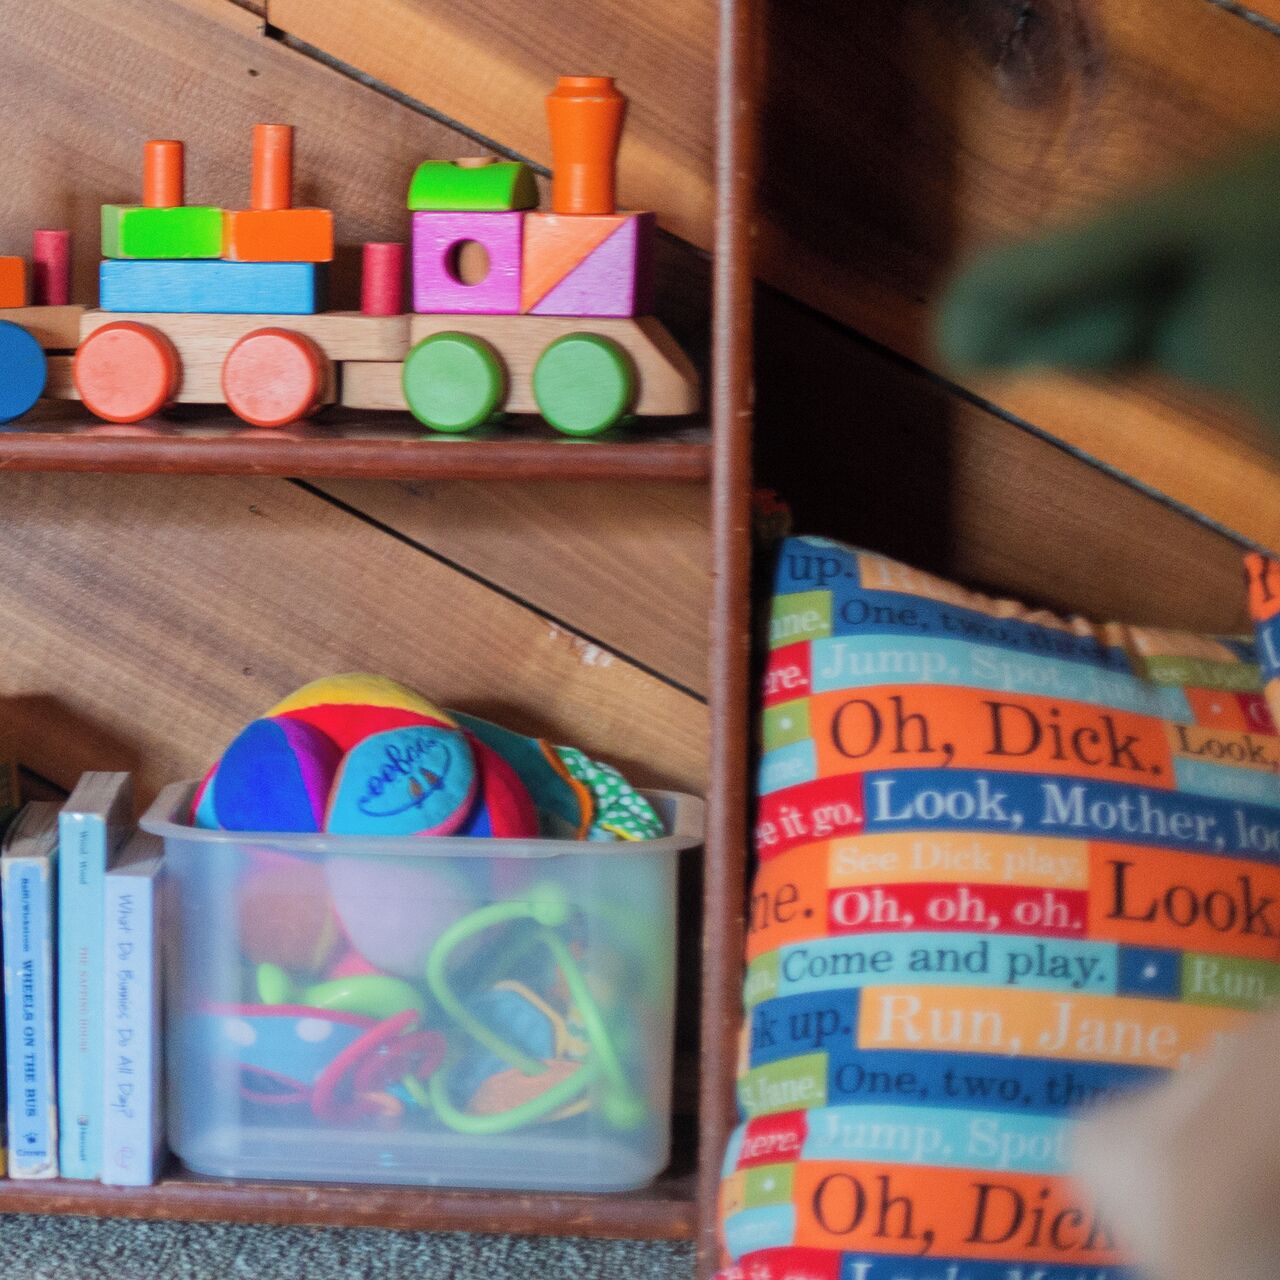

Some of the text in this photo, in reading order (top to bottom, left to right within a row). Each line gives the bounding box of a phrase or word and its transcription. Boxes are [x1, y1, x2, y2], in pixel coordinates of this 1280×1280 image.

[789, 553, 856, 586] up.
[842, 598, 930, 632] One,
[820, 642, 960, 683] Jump,
[831, 695, 955, 768] Oh,
[981, 699, 1163, 776] Dick.
[780, 803, 863, 838] it go.
[872, 778, 1024, 831] Look,
[1041, 782, 1227, 853] Mother,
[837, 844, 898, 876] See
[911, 841, 998, 871] Dick
[832, 859, 1280, 937] Oh, oh, oh. Look
[782, 947, 894, 983] Come
[908, 940, 991, 975] and
[1007, 943, 1107, 989] play.
[110, 894, 134, 1118] What Do Bunnies Do All Day?
[790, 1006, 852, 1048] up.
[876, 994, 1023, 1057] Run,
[21, 960, 36, 1116] WHEELS ON THE BUS
[834, 1062, 929, 1100] One,
[943, 1070, 1032, 1104] two,
[814, 1114, 952, 1163] Jump,
[811, 1172, 935, 1255] Oh,
